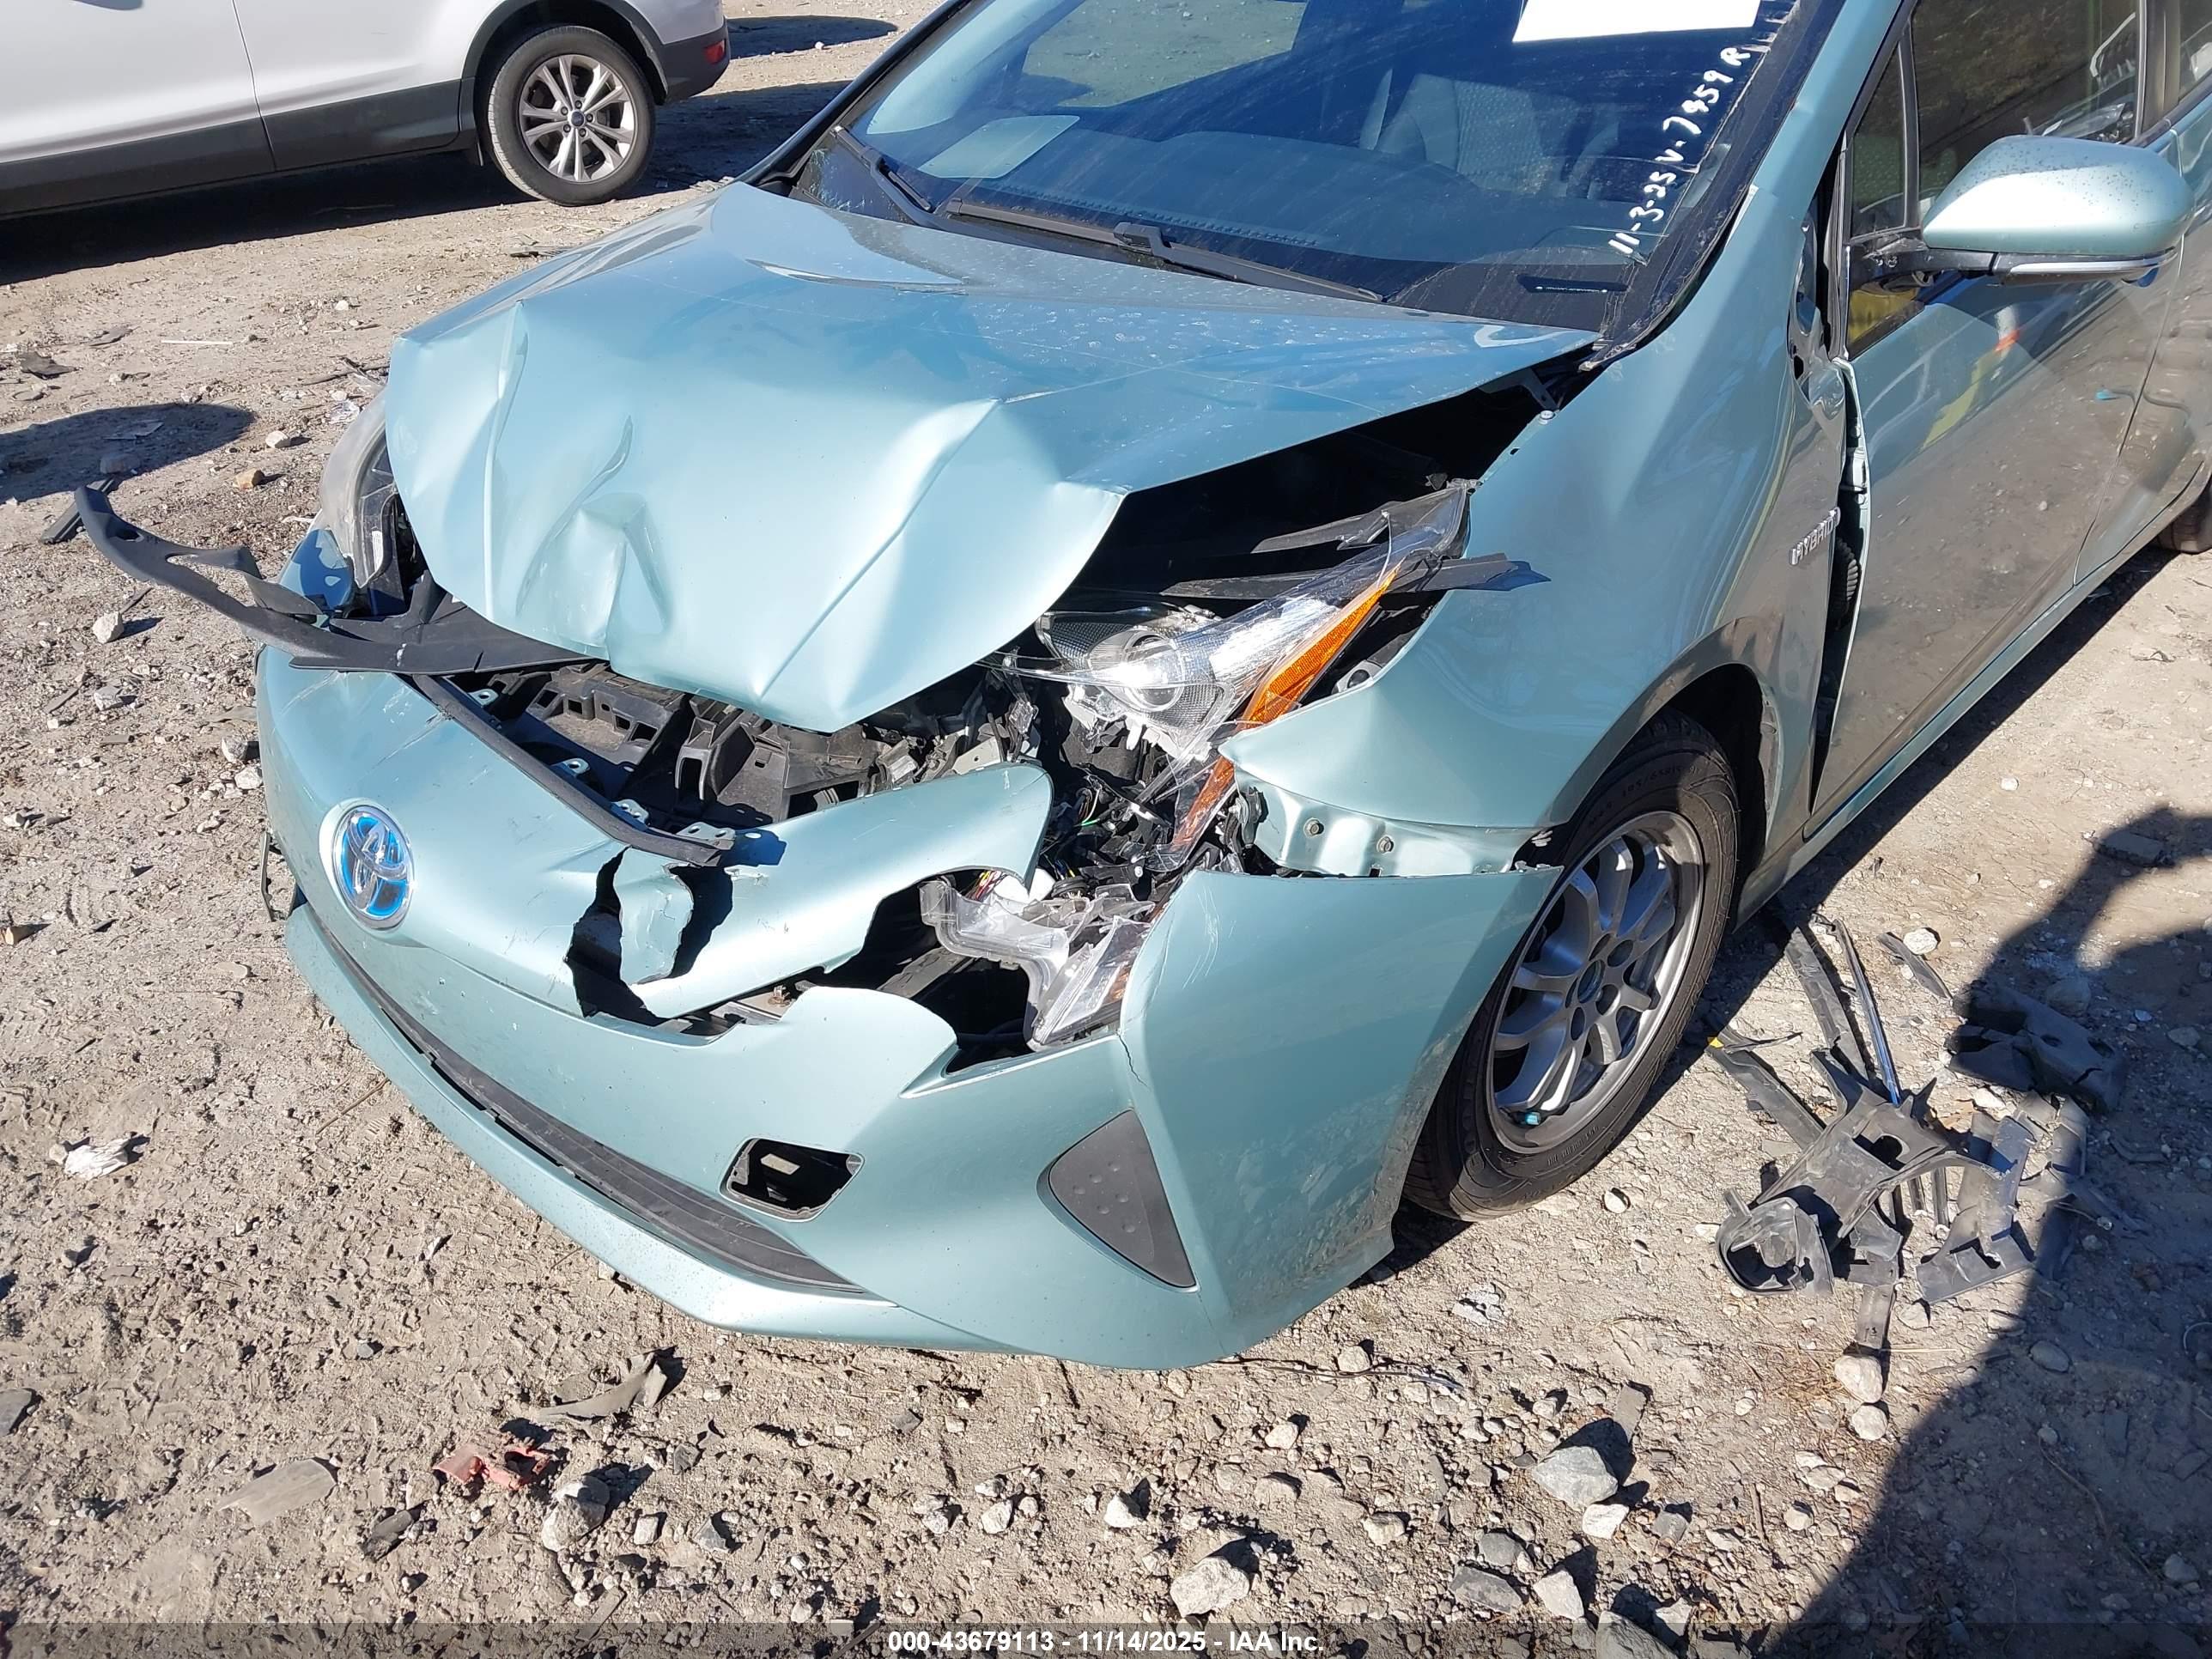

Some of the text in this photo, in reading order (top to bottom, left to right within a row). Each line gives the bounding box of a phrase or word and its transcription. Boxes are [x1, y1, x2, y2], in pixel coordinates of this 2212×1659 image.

[1607, 171, 1677, 254] 11-3-25
[1720, 47, 1751, 67] R
[1796, 516, 1835, 561] HYBRID
